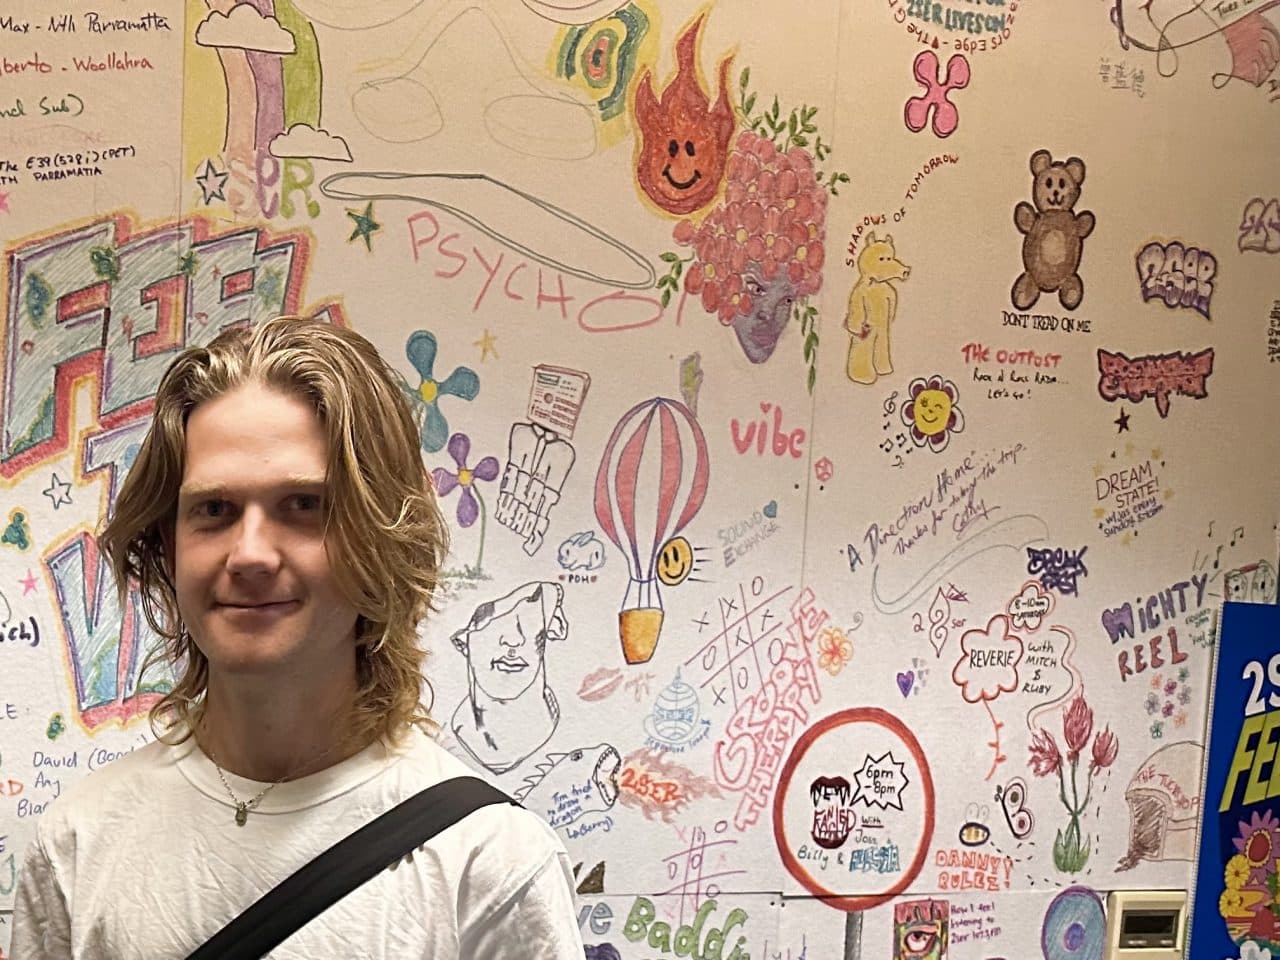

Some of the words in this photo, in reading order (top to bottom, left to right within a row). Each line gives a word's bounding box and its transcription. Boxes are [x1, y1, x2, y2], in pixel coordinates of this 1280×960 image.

[73, 51, 154, 72] Woollahra
[844, 214, 888, 268] SHADOWS
[893, 208, 907, 223] OF
[1076, 320, 1091, 333] ME
[730, 402, 806, 459] vibe
[1095, 460, 1154, 501] DREAM
[1115, 478, 1160, 509] STATE!
[970, 649, 1015, 669] REVERIE
[1026, 656, 1057, 667] MITCH
[1118, 626, 1190, 681] REEL
[32, 751, 77, 768] David
[866, 765, 894, 784] 6pm
